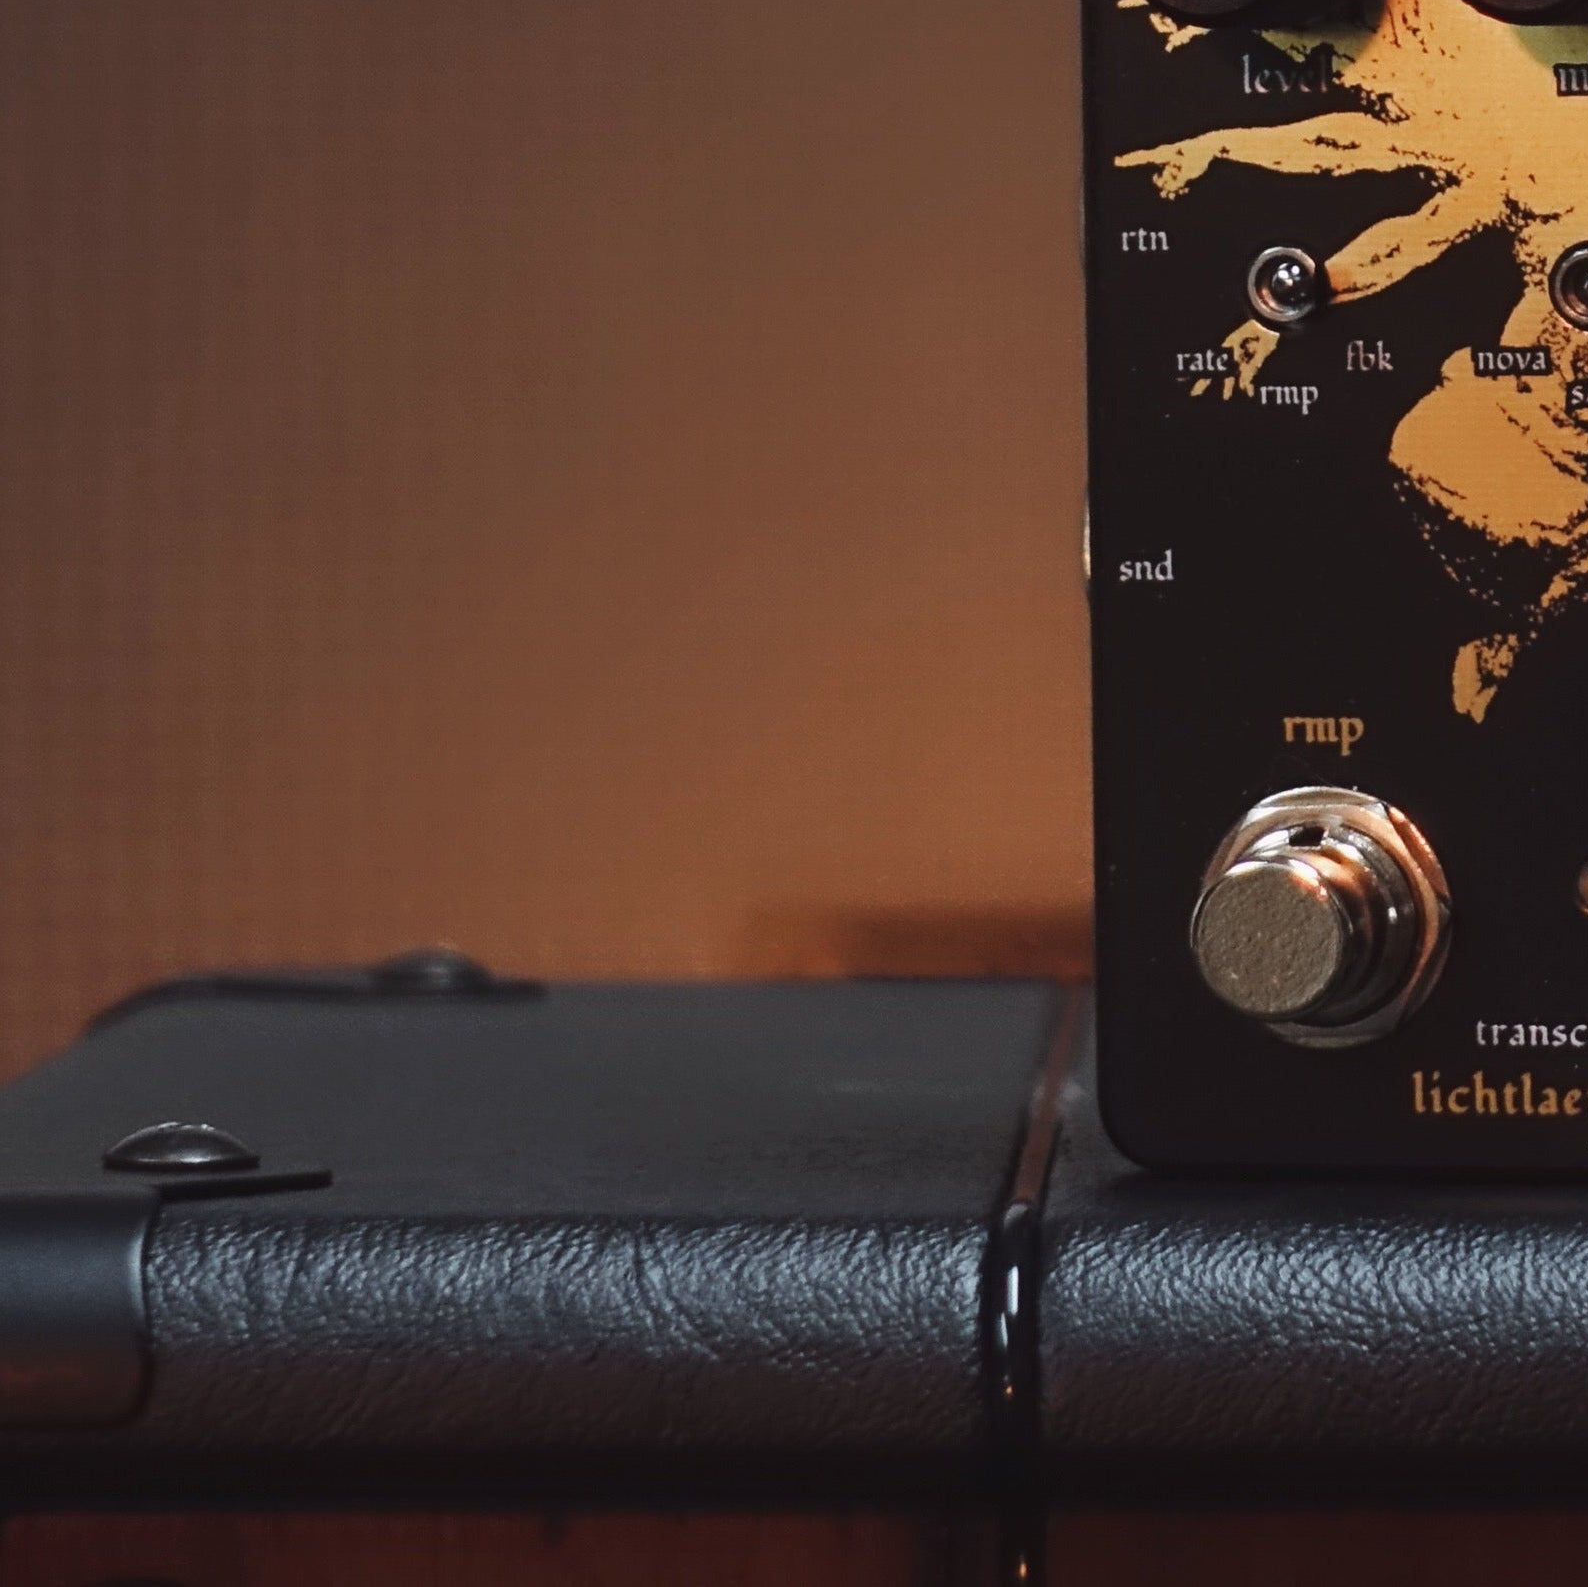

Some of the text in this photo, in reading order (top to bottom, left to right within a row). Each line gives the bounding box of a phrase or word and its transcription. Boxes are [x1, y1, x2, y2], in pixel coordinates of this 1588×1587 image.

[1242, 53, 1328, 93] level
[1120, 227, 1169, 251] rtn
[1176, 349, 1230, 374] rate
[1346, 340, 1394, 371] fbk
[1477, 349, 1547, 371] nova
[1260, 383, 1319, 415] rmp
[1119, 549, 1174, 582] snd
[1283, 714, 1364, 756] rmp
